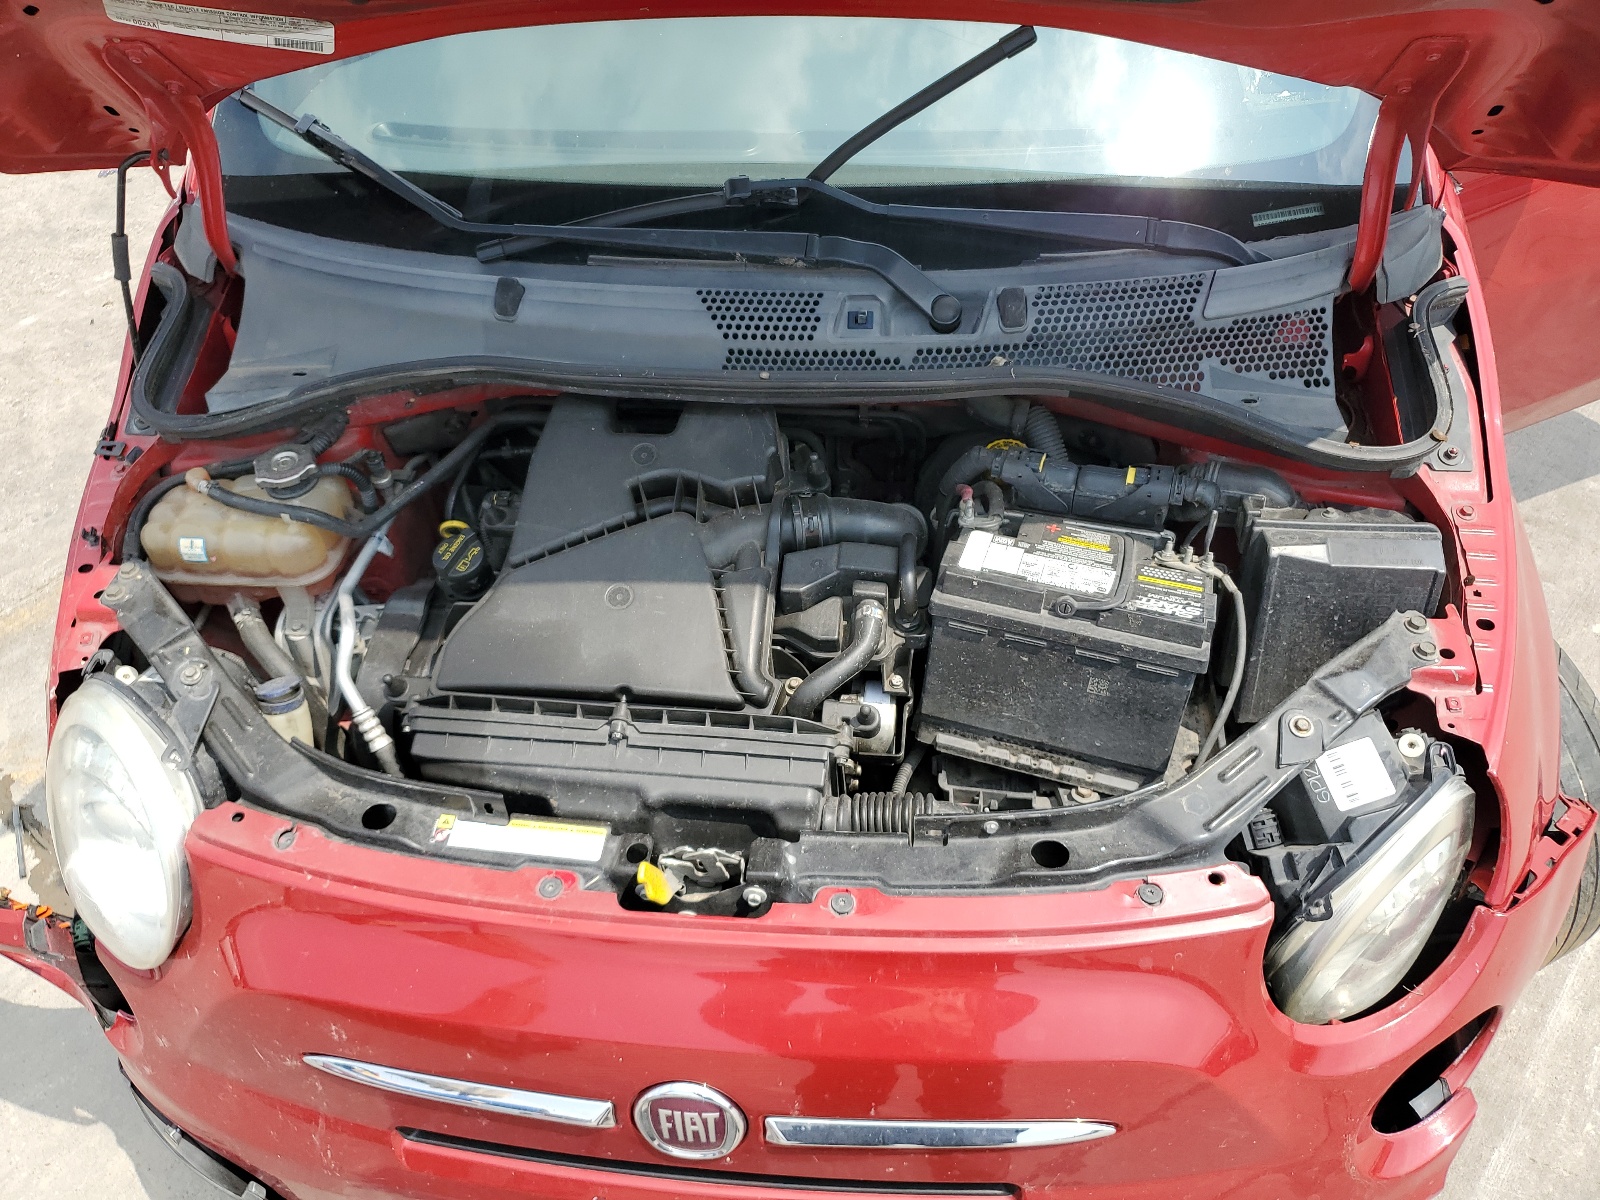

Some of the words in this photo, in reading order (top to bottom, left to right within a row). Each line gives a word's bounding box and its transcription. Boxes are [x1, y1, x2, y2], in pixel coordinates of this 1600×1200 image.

[1136, 595, 1204, 616] START
[1147, 592, 1202, 607] PLATINUM
[658, 1108, 720, 1143] FIAT
